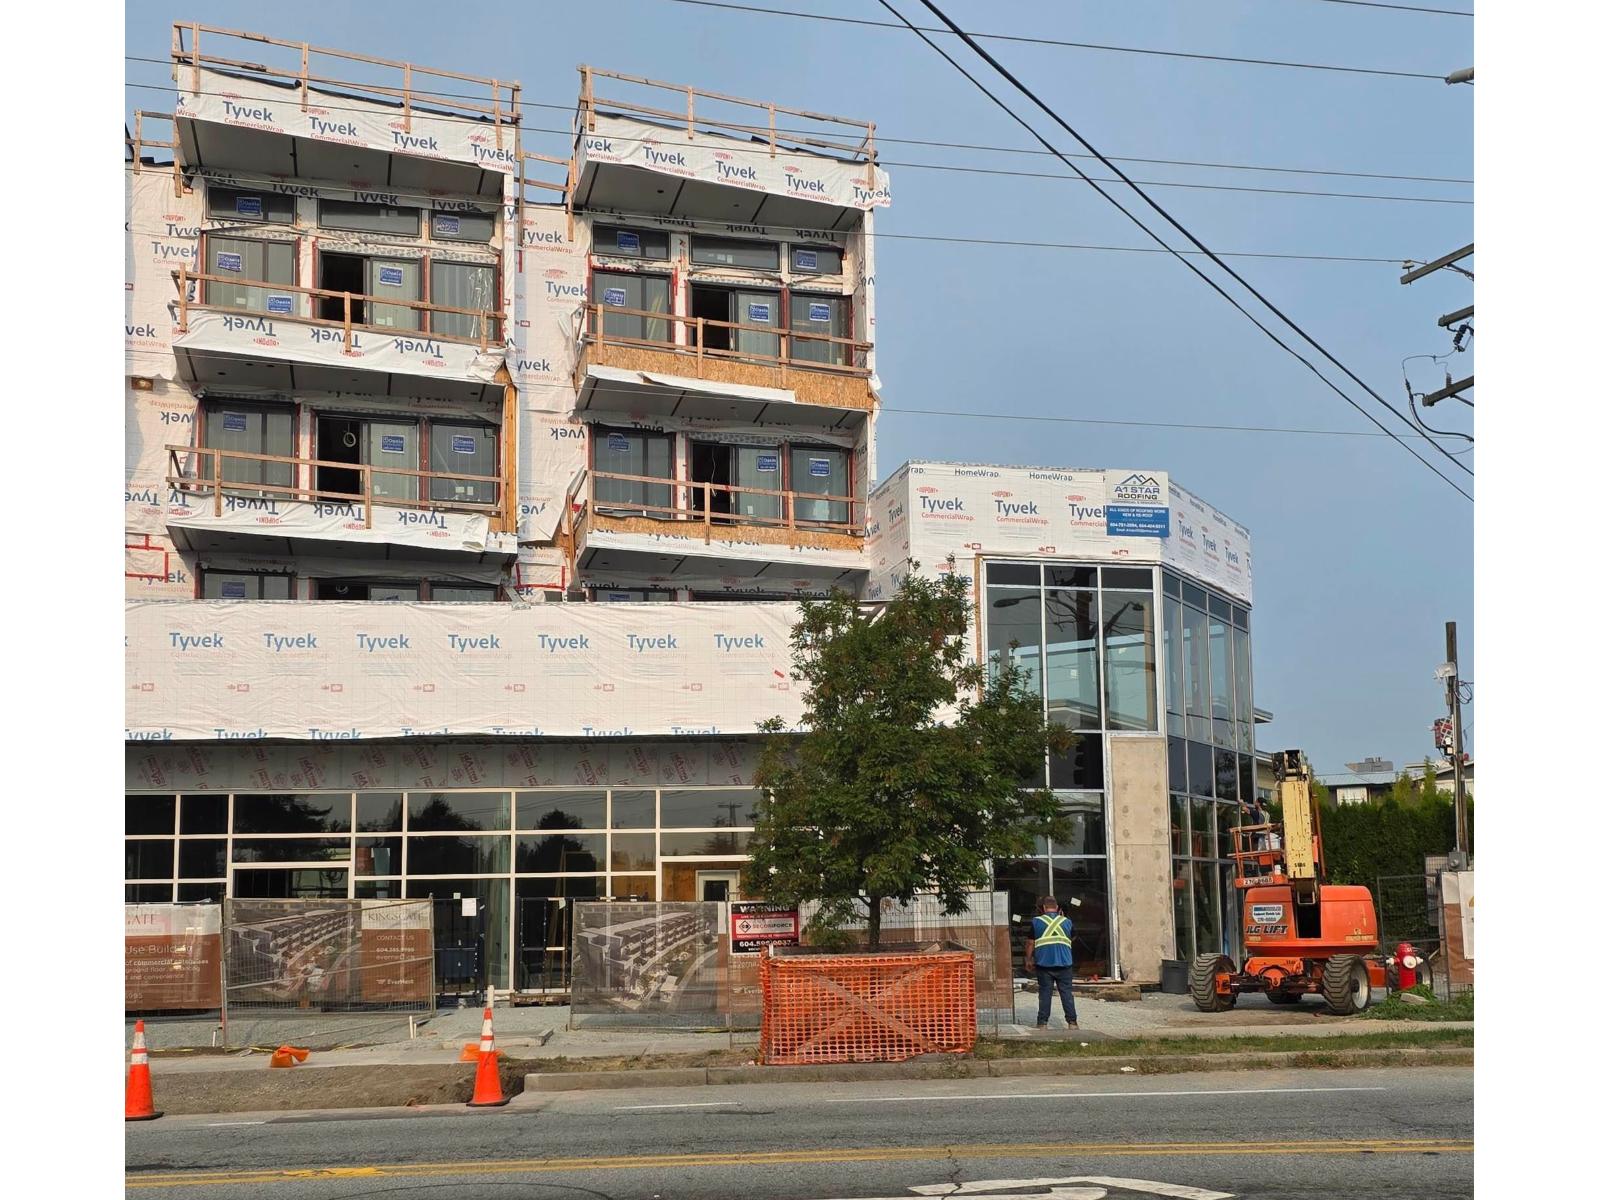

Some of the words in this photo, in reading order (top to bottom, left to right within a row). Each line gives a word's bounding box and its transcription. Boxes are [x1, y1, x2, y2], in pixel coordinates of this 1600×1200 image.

[222, 101, 274, 124] Tyvek
[308, 116, 357, 138] Tyvek
[391, 131, 439, 151] Tyvek
[586, 139, 613, 154] vek
[471, 144, 515, 163] Tyvek
[643, 146, 686, 168] Tyvek
[715, 160, 757, 181] Tyvek
[785, 174, 825, 194] Tyvek
[853, 187, 891, 204] Tyvek
[166, 223, 201, 237] Tyve
[522, 228, 563, 244] Tyvek
[151, 241, 199, 259] Tyvek
[545, 281, 588, 298] Tyvek
[126, 324, 155, 338] vek
[223, 315, 276, 337] Tyvek
[394, 338, 444, 360] Tyvek
[518, 359, 551, 373] yvek
[160, 411, 193, 425] vek
[550, 427, 586, 441] yvek
[955, 468, 1000, 479] HomeWrap
[126, 489, 161, 507] Tyve
[226, 497, 279, 516] Tyvek
[920, 496, 964, 513] Tyvek
[313, 503, 364, 521] Tyvek
[921, 512, 976, 522] CommercialWrap
[994, 500, 1038, 517] Tyvek
[398, 511, 448, 530] Tyvek
[996, 516, 1049, 526] CommercialWrap
[1071, 520, 1106, 529] Commercial
[169, 632, 224, 652] Tyvek
[263, 633, 318, 653] Tyvek
[356, 634, 411, 653] Tyvek
[448, 634, 501, 653] Tyvek
[538, 634, 590, 654] Tyvek
[627, 634, 678, 653] Tyvek
[714, 633, 765, 653] Tyvek
[308, 728, 362, 740] Tyvek
[740, 904, 791, 913] WANING
[1246, 925, 1261, 934] JLG
[1263, 925, 1287, 934] LIFT
[148, 944, 193, 957] Buildg
